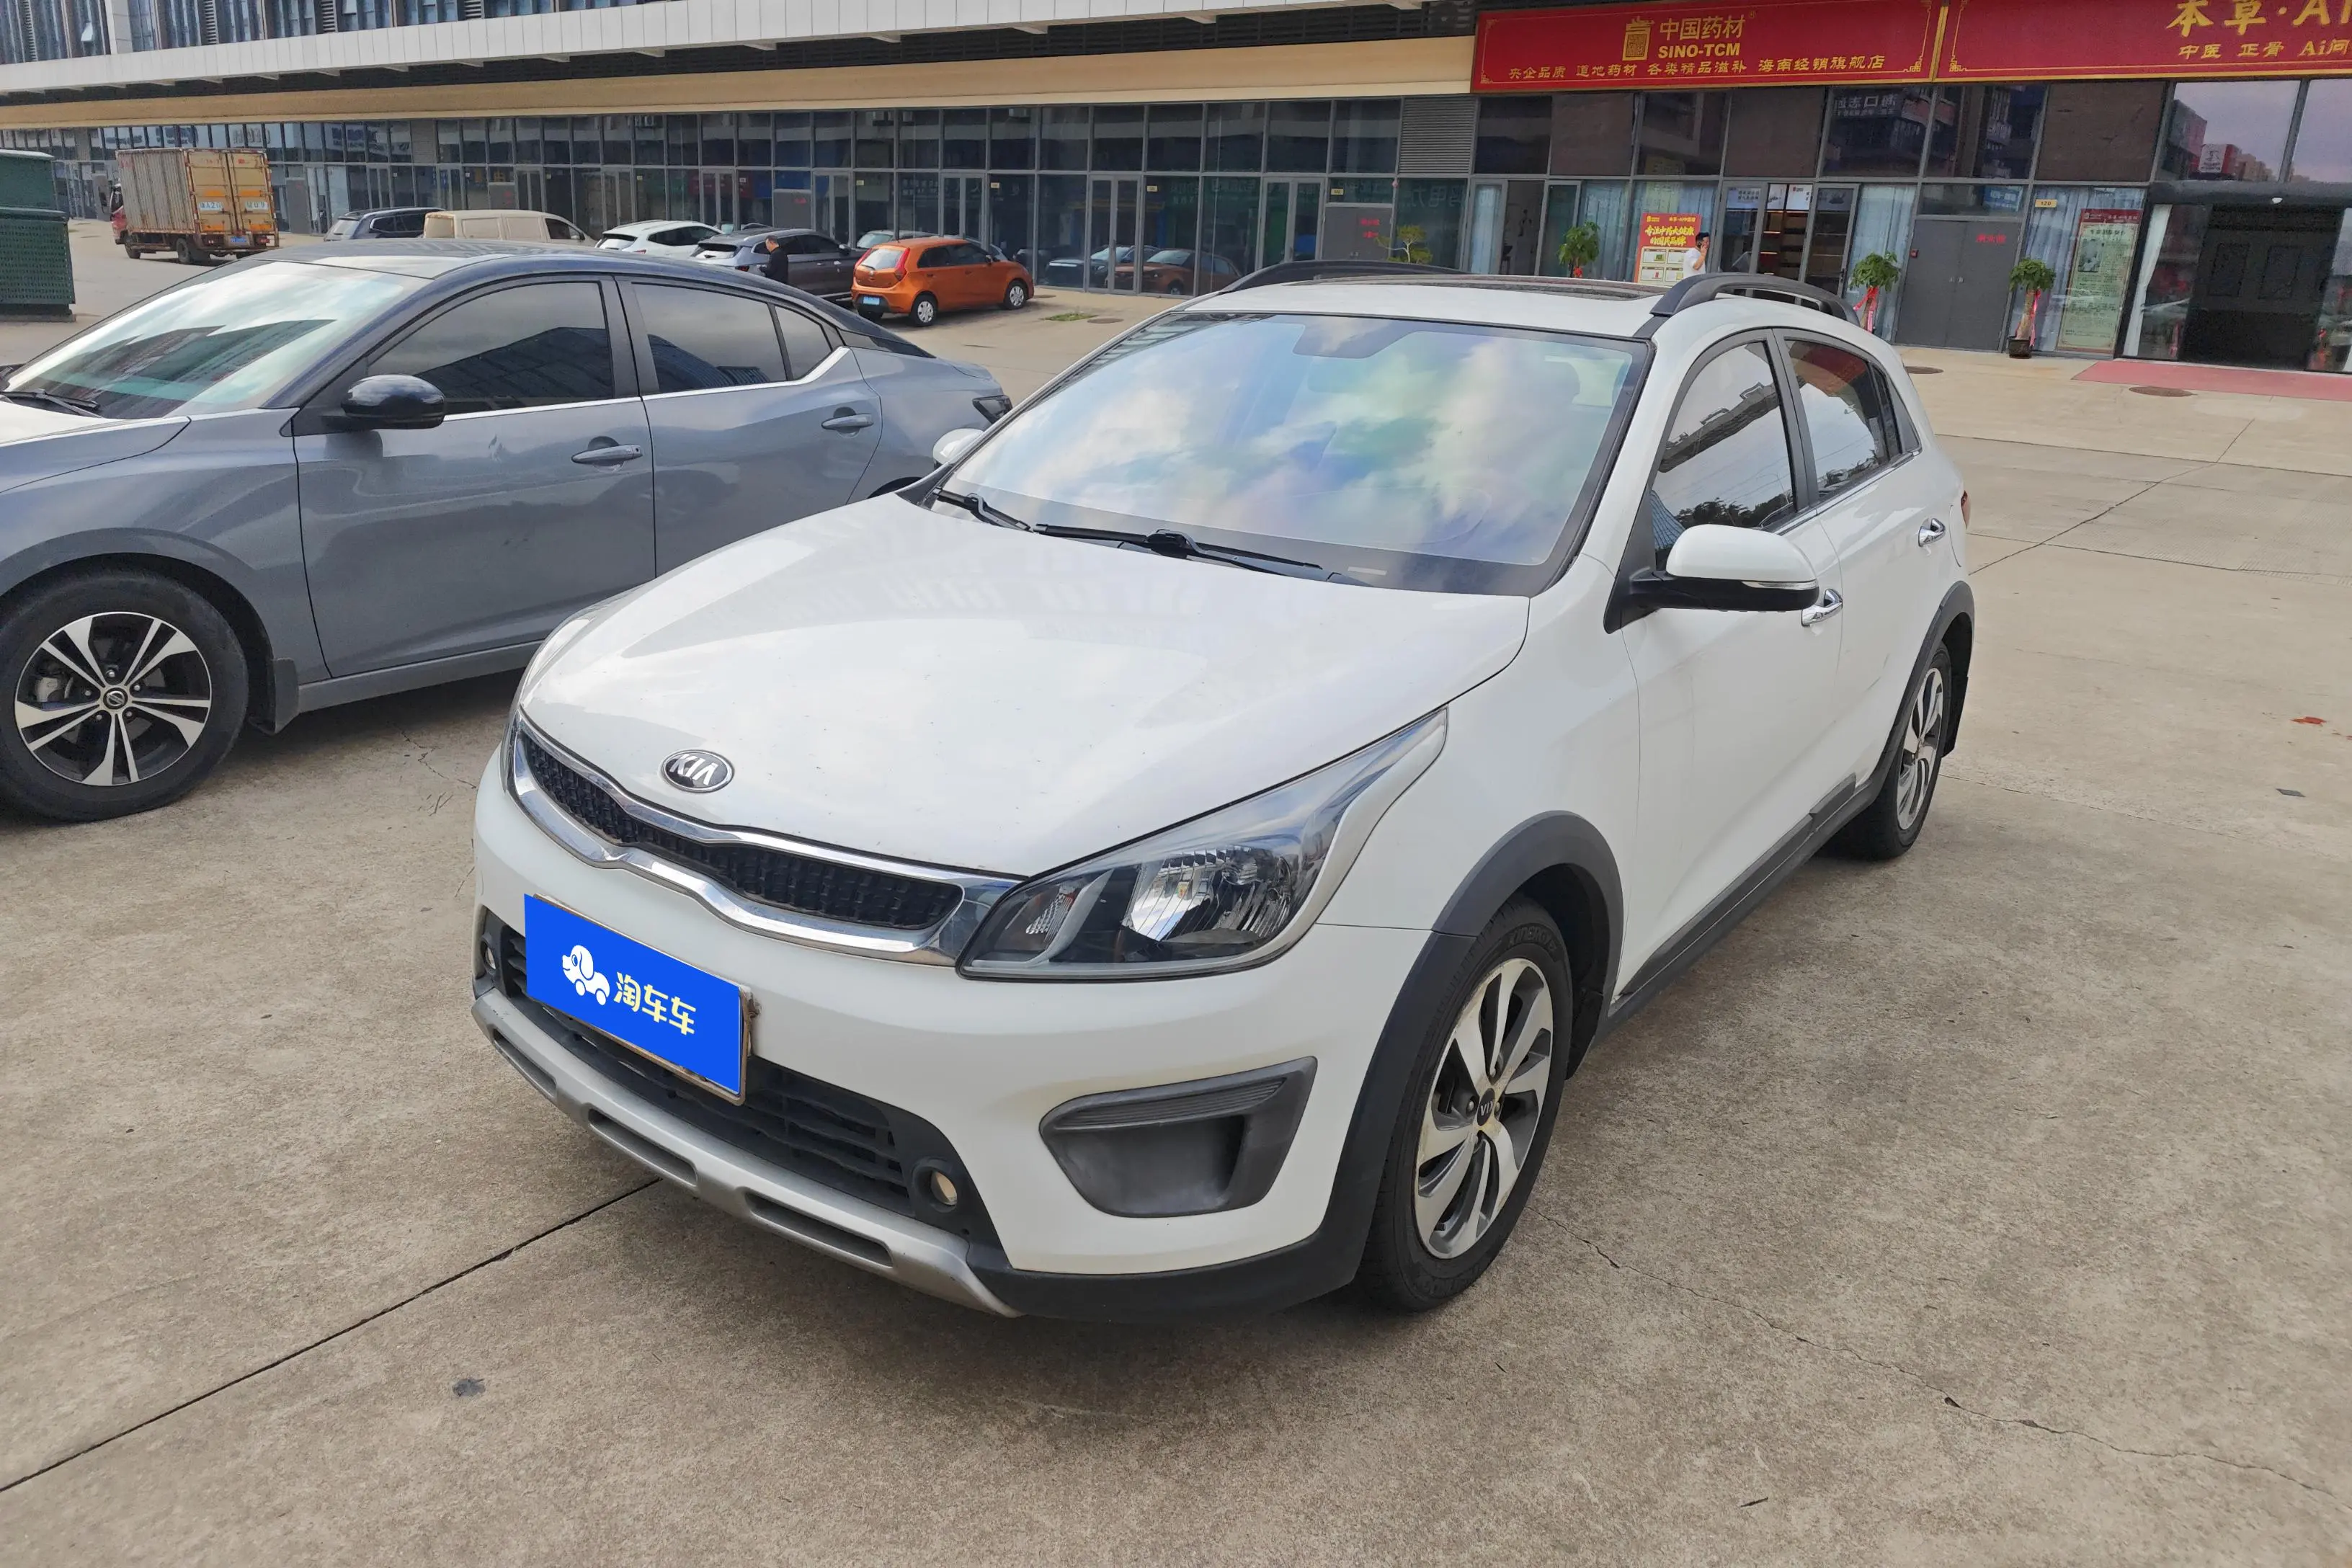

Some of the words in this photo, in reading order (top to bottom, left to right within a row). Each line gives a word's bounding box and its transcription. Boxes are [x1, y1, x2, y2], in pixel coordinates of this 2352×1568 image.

[1660, 14, 1745, 40] 中国药材
[1658, 43, 1740, 58] SINO-TCM
[2178, 44, 2222, 59] 中医
[2237, 41, 2284, 57] 正骨
[1509, 66, 1566, 79] 央企品质
[1576, 64, 1637, 77] 道地药材
[1647, 59, 1747, 76] 各类精品滋补
[1758, 55, 1885, 72] 海南经销旗舰店
[669, 753, 718, 785] KIA
